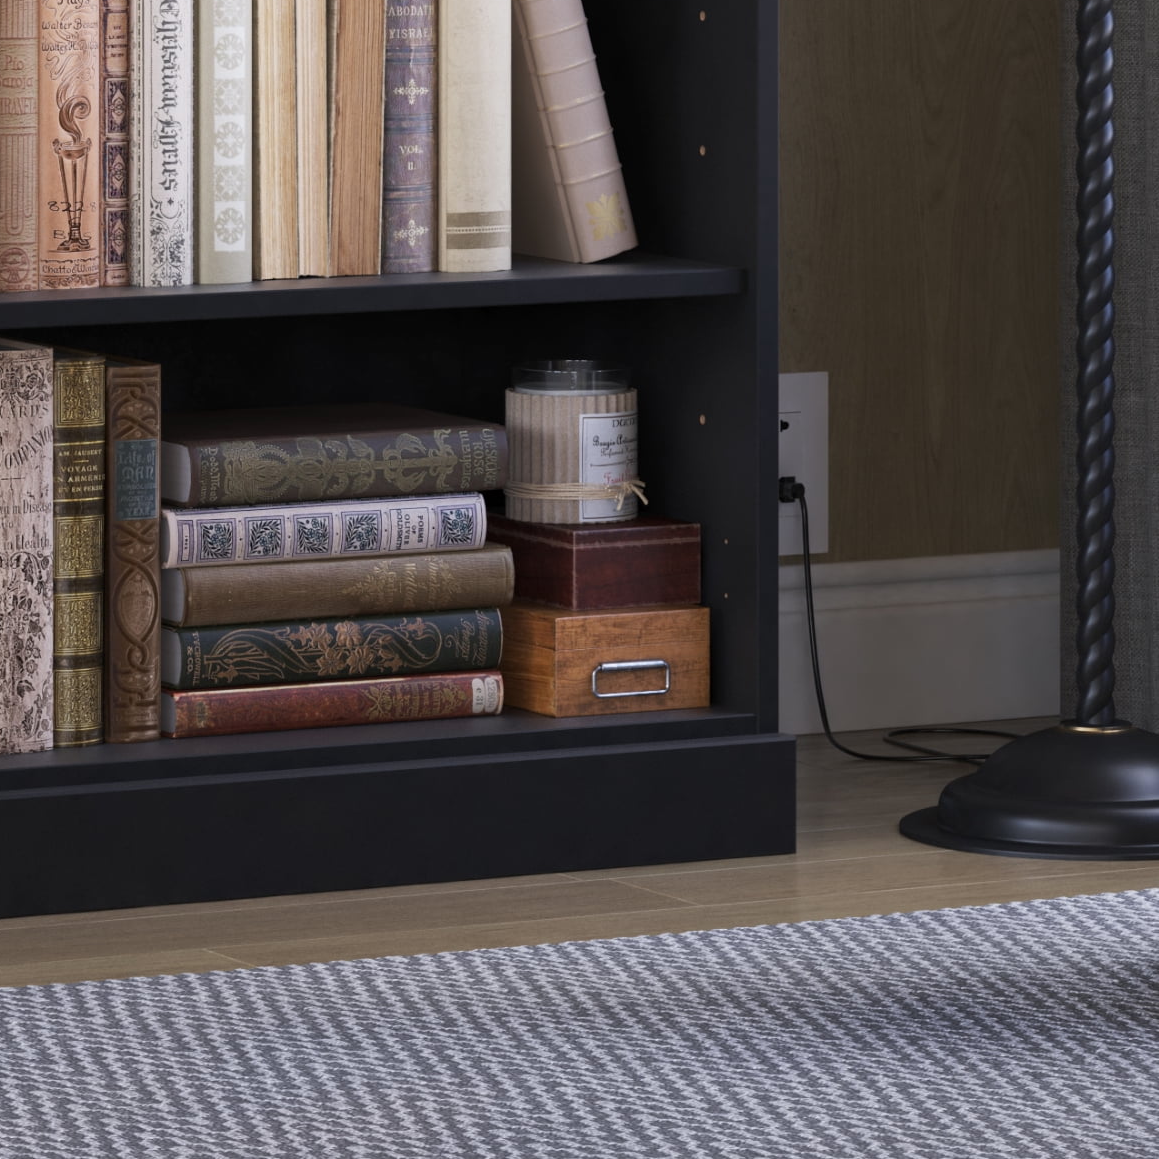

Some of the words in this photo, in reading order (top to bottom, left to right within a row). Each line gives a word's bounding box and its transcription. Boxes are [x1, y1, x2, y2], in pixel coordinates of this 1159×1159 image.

[41, 21, 72, 30] Walter
[60, 465, 98, 473] VOYAGE
[403, 513, 411, 545] OLIVER
[417, 515, 425, 543] POEMS
